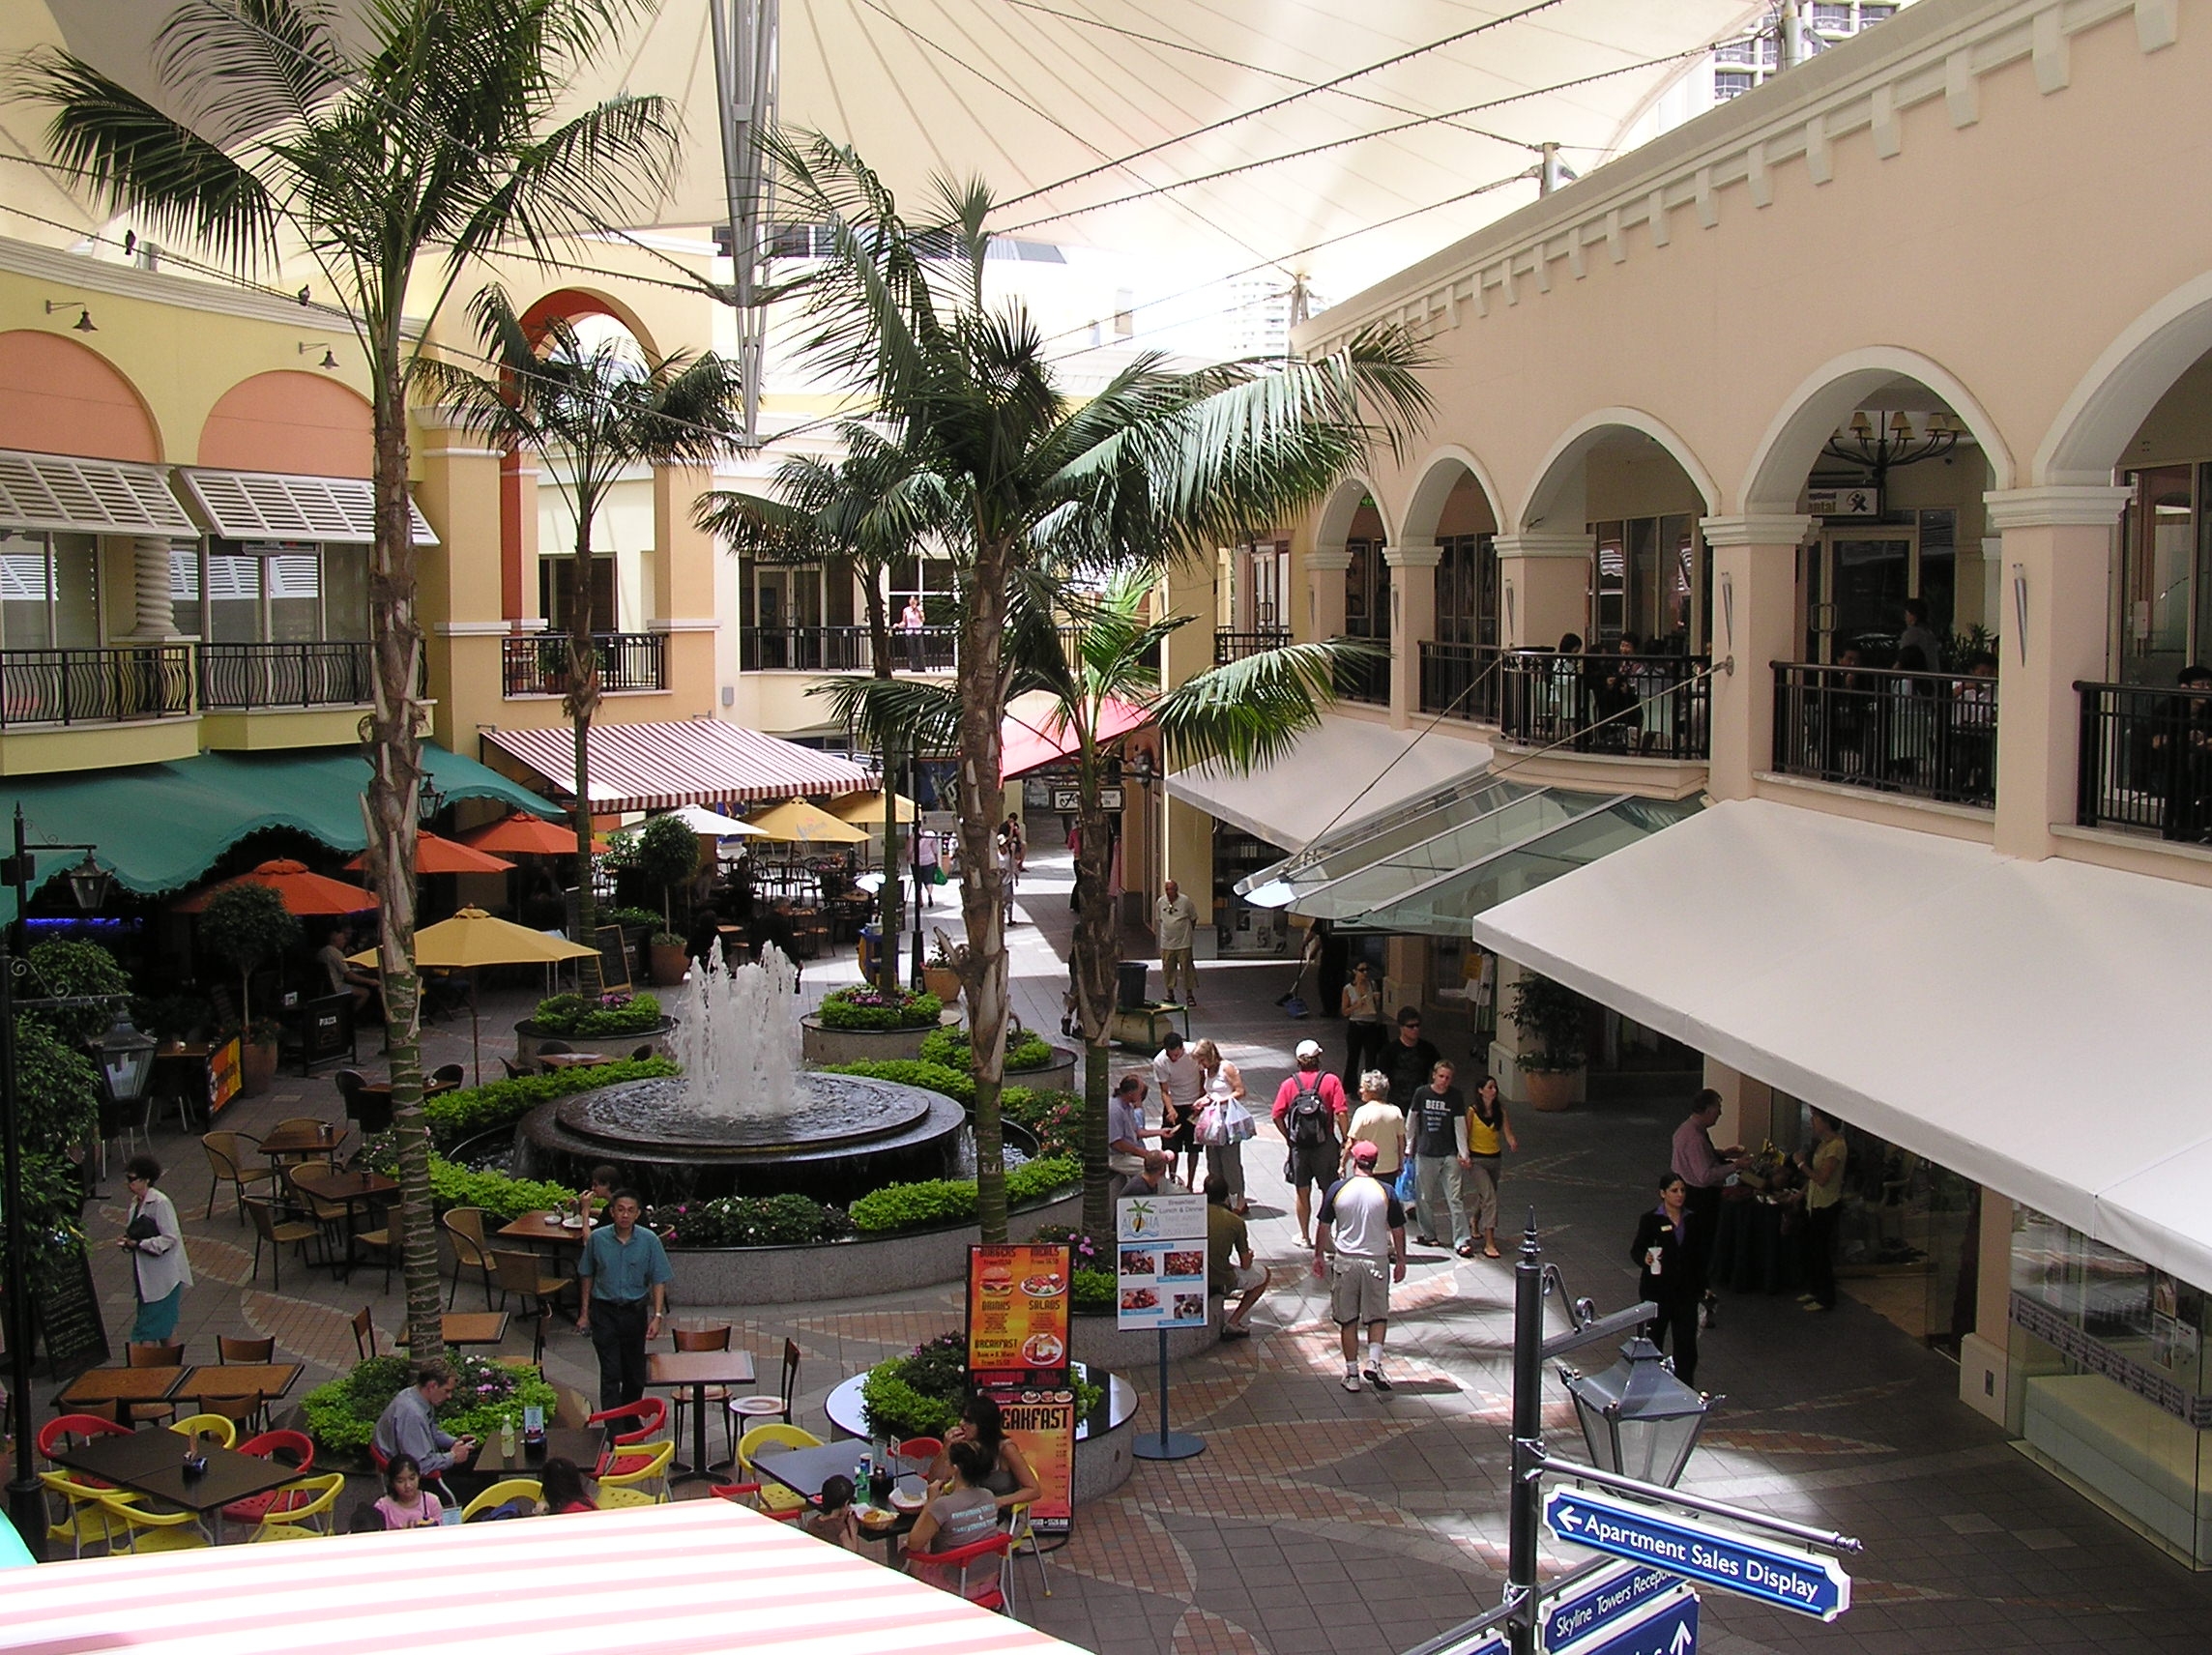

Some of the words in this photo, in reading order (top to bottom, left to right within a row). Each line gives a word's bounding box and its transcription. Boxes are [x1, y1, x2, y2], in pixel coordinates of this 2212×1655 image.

[1029, 1299, 1061, 1311] SALADS
[975, 1338, 1018, 1350] BREAKFAST
[1002, 1408, 1070, 1430] EAKFAST
[1585, 1514, 1686, 1561] Apartment
[1692, 1544, 1739, 1577] Sales
[1746, 1559, 1819, 1603] Display
[1556, 1607, 1592, 1638] Skyline
[1596, 1584, 1632, 1615] Towers
